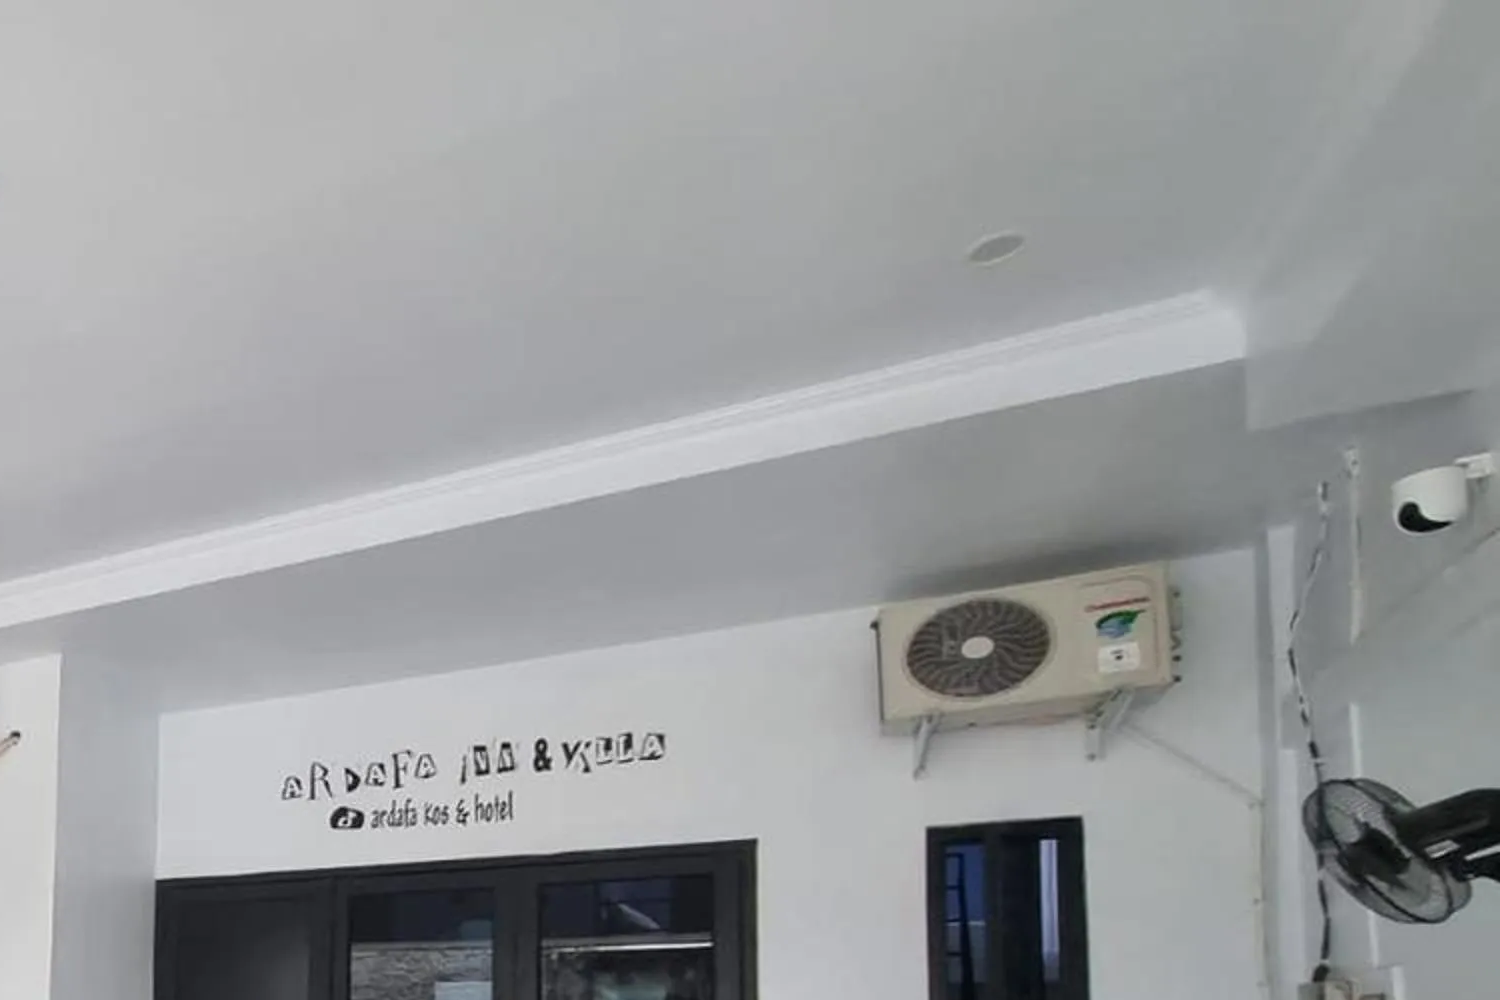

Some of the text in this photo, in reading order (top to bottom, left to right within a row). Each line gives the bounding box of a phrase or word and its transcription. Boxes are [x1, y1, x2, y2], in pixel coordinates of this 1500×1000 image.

[533, 738, 551, 773] &
[370, 798, 418, 829] ardafa
[456, 799, 470, 825] &
[474, 790, 514, 823] hotel
